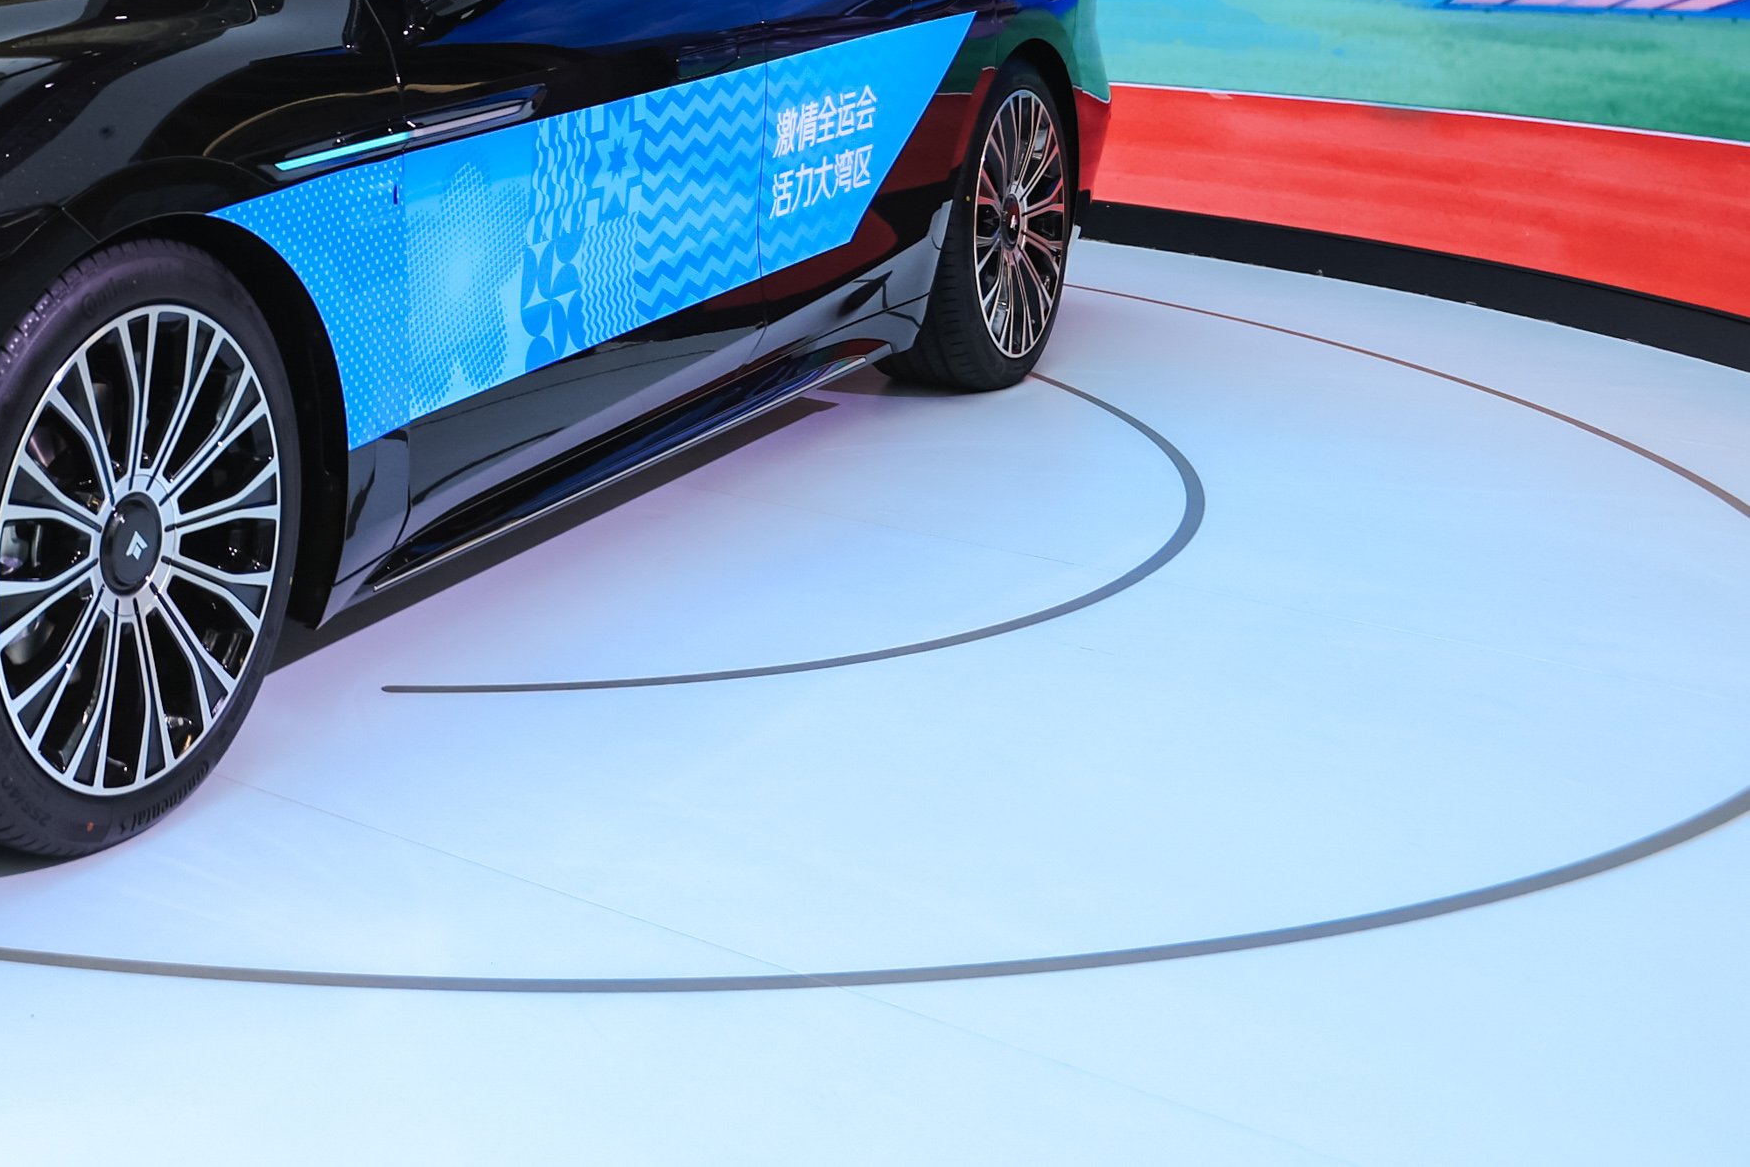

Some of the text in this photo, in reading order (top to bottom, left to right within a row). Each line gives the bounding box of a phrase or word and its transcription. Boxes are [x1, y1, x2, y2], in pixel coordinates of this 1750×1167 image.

[772, 84, 878, 159] 激情全运会
[769, 144, 874, 220] 活力大湾区
